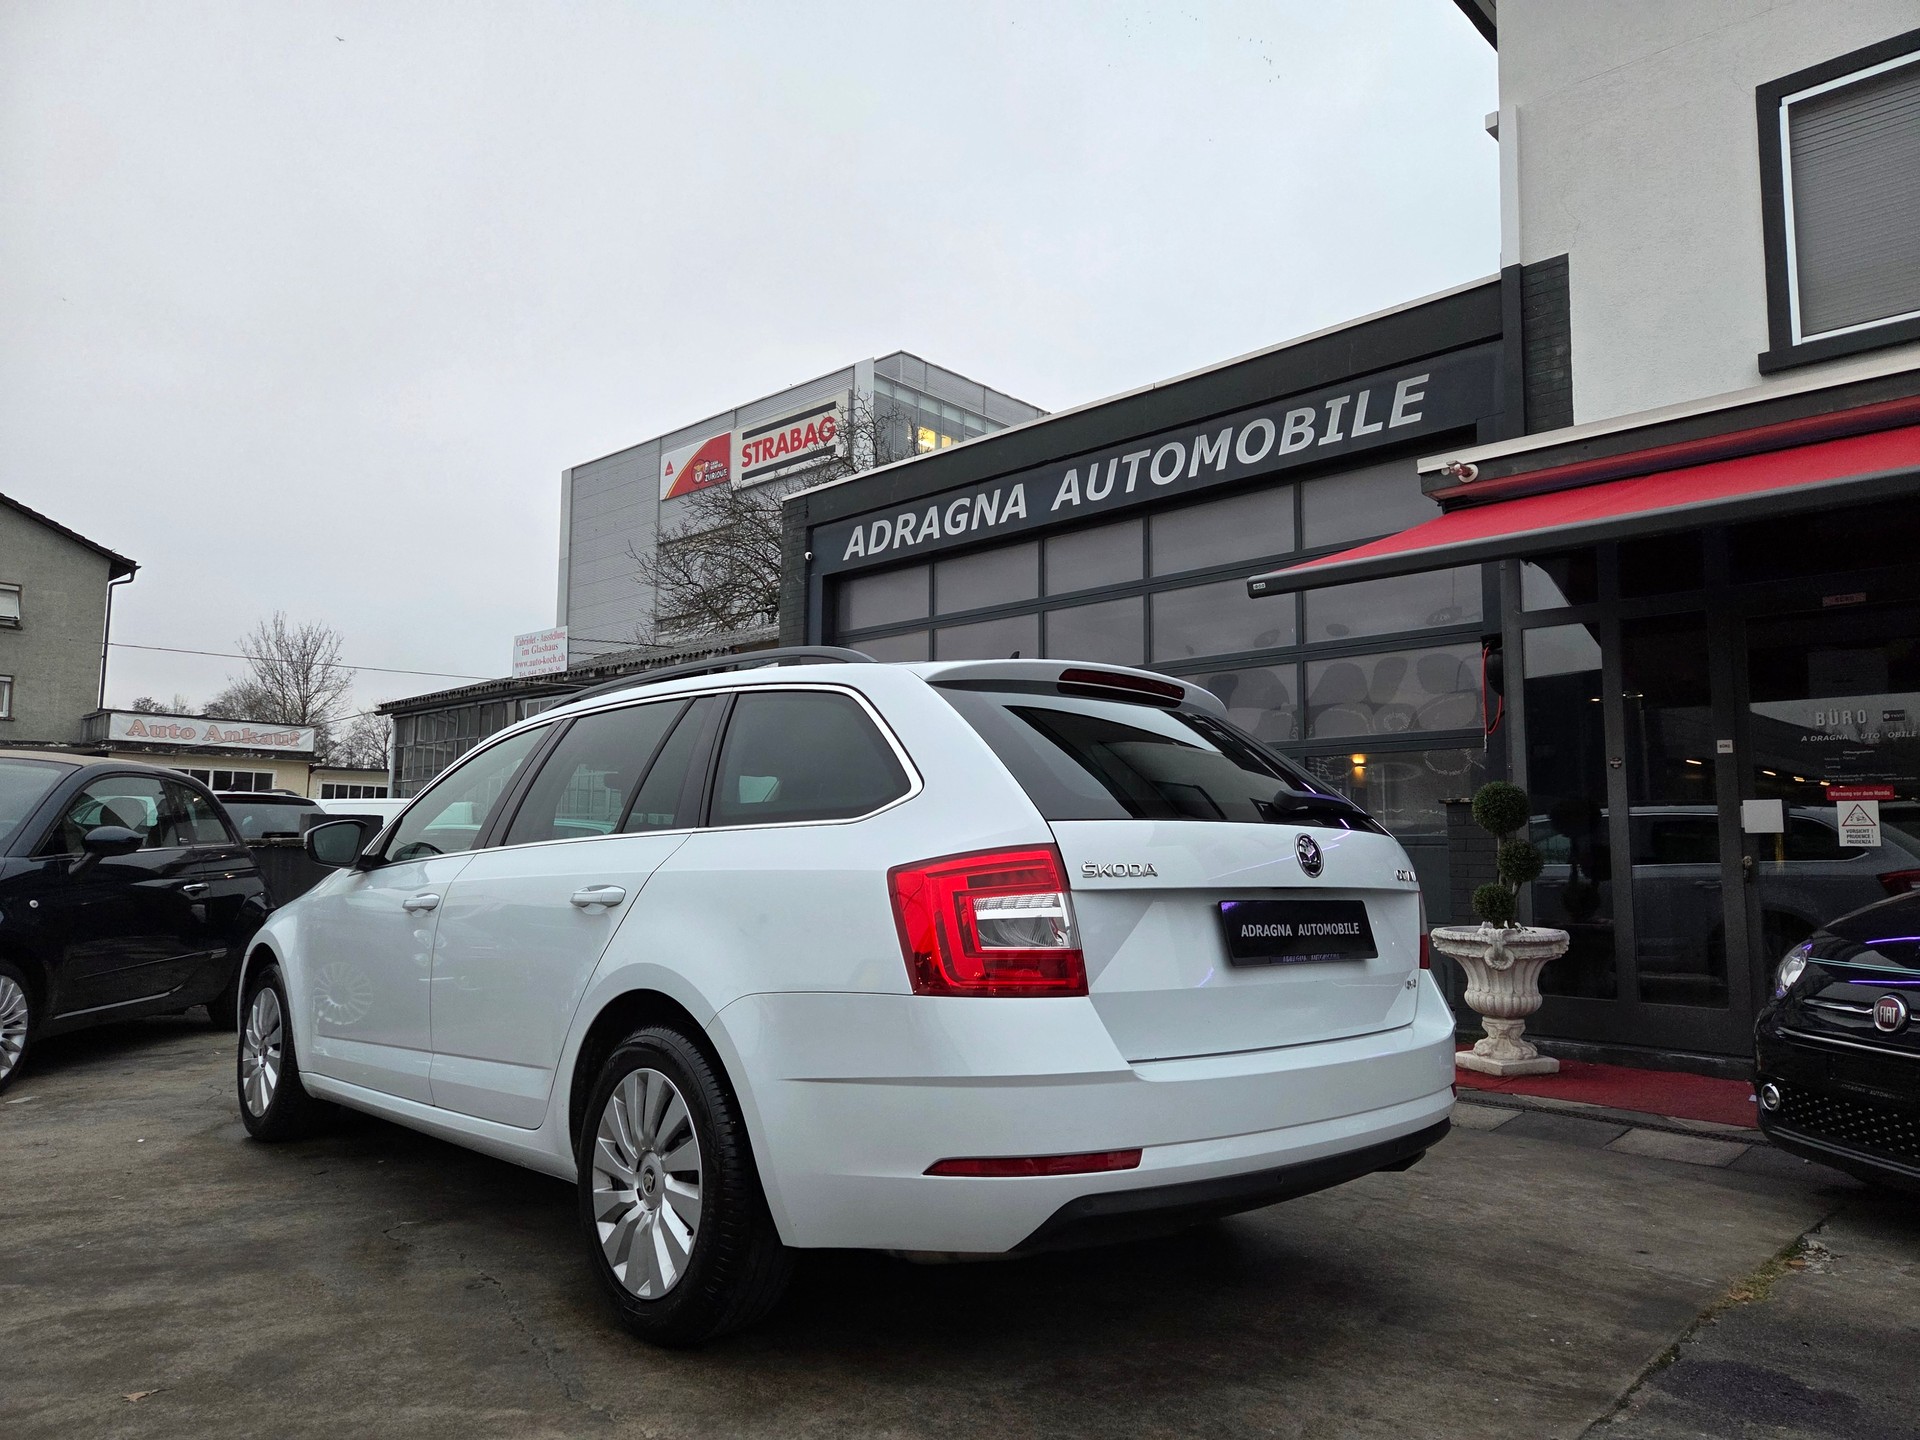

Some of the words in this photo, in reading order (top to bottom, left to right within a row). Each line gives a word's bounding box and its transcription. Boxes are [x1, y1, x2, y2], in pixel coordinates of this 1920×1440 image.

[741, 416, 836, 468] STRABAG
[842, 483, 1027, 561] ADRAGNA
[1052, 373, 1431, 511] AUTOMOBILE
[522, 647, 530, 656] im
[531, 644, 559, 655] Glashaus
[515, 652, 566, 668] www.auto-koch.ch
[1815, 708, 1867, 727] BÜRO
[126, 719, 197, 740] Auto
[202, 725, 301, 747] Ankauf
[1081, 860, 1159, 879] ŠKODA
[1241, 923, 1293, 938] ADRAGNA
[1298, 922, 1360, 937] AUTOMOBILE
[1879, 1006, 1898, 1024] FIAT
